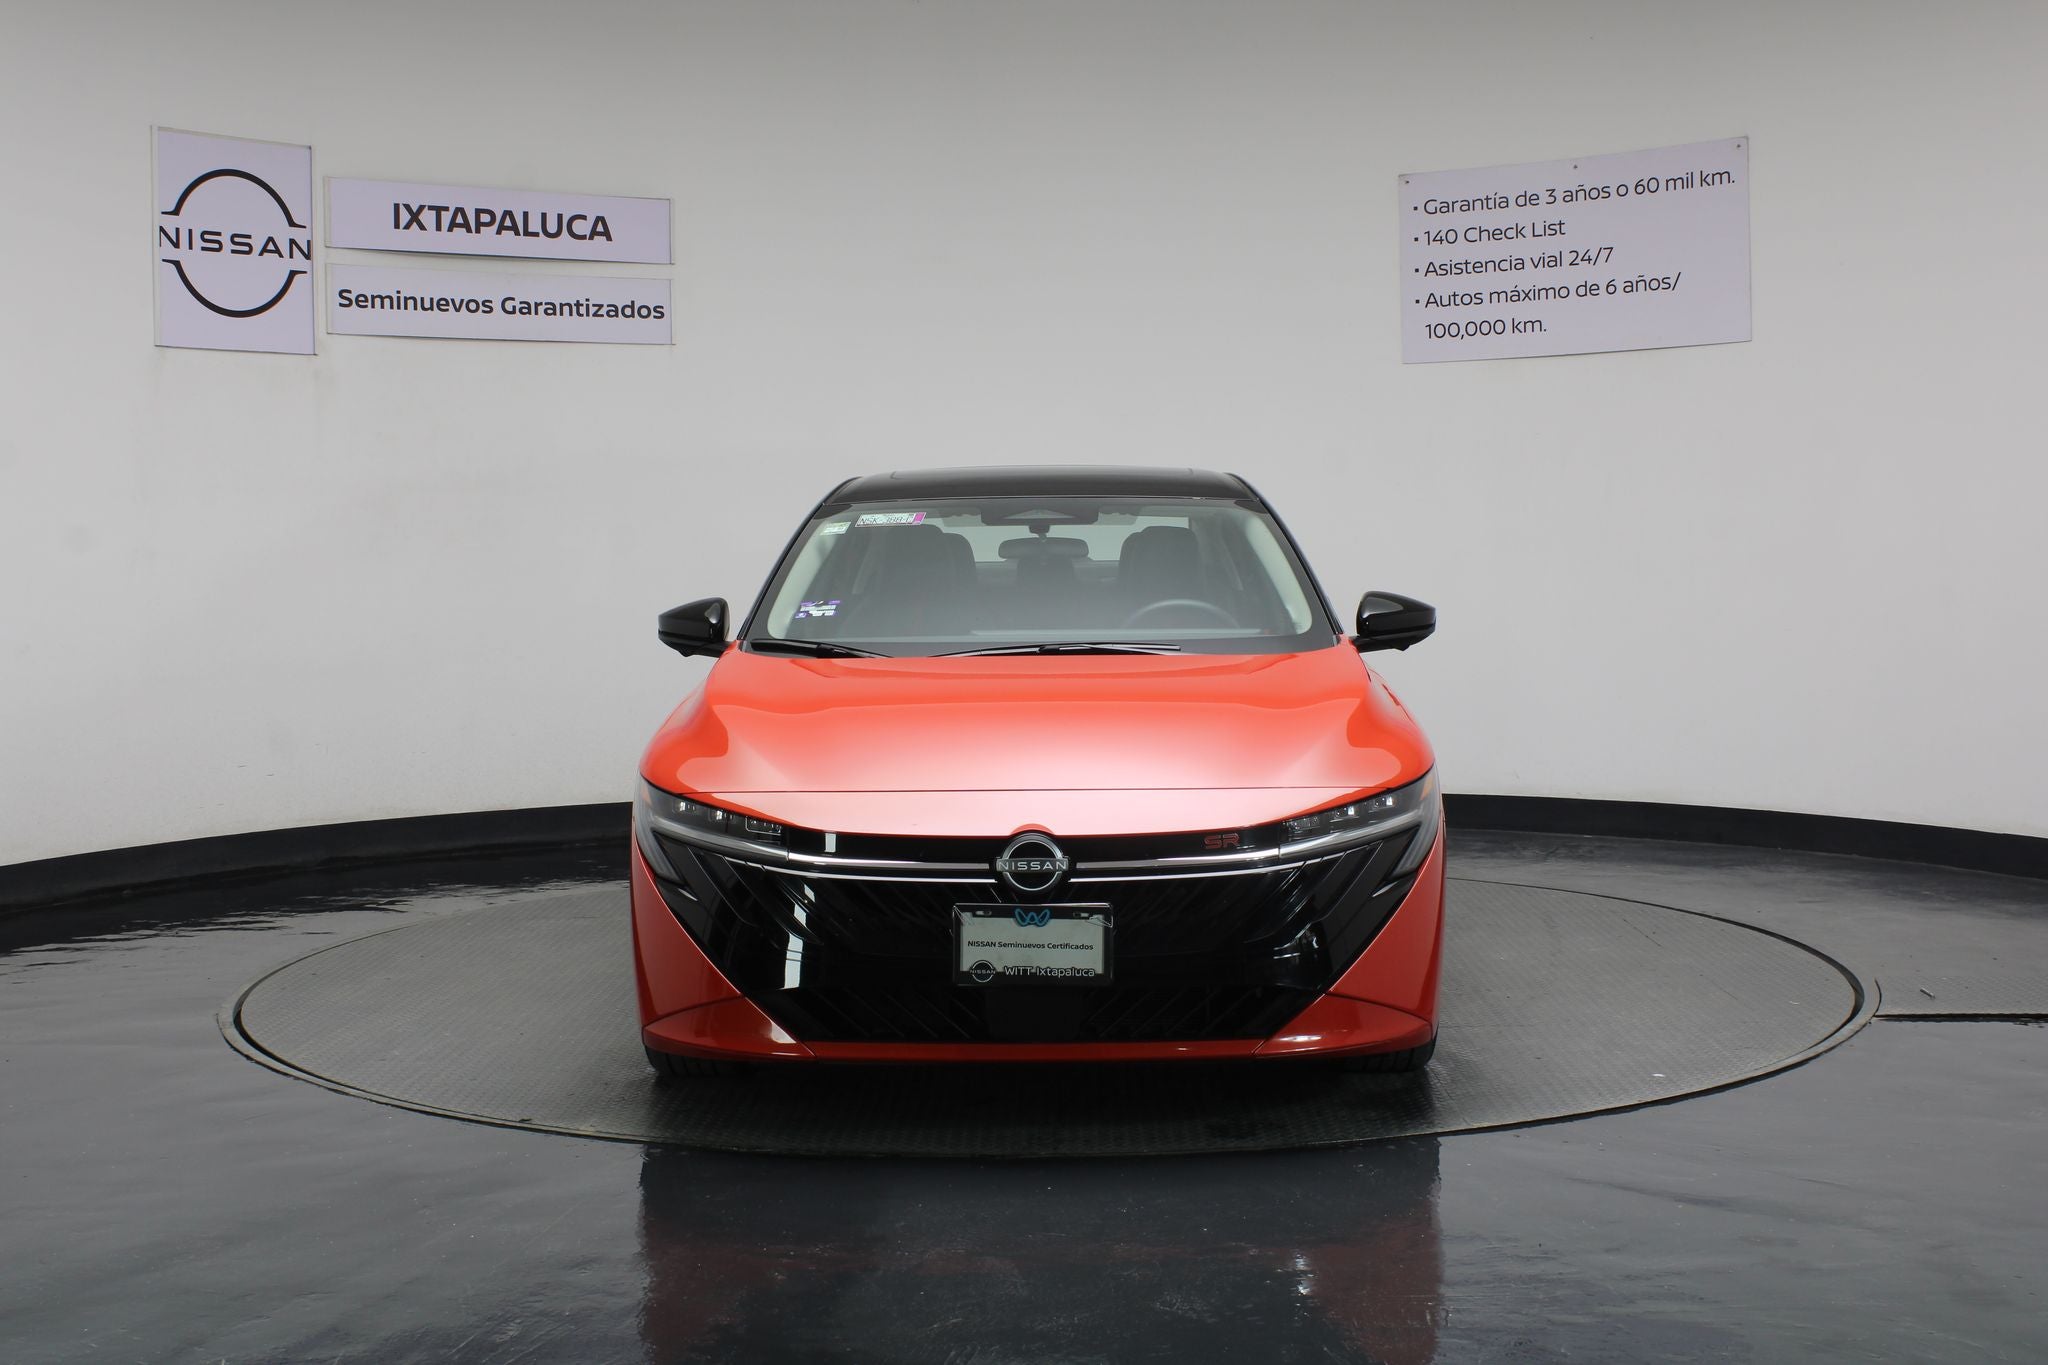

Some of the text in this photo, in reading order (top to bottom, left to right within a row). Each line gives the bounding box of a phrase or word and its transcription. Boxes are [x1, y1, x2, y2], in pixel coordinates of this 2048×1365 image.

[1424, 170, 1735, 214] Garantía de 3 años o 60 mil km.
[394, 203, 613, 242] IXTAPALUCA
[1424, 220, 1566, 246] 140 Check List
[159, 225, 311, 261] NISSAN
[1424, 247, 1614, 277] Asistencia vial 24/7
[338, 289, 664, 319] Seminuevos Garantizados
[1425, 272, 1681, 308] Autos máximo de 6 años/
[1425, 318, 1546, 340] 100,000 km.
[1204, 833, 1240, 849] SR
[999, 861, 1067, 870] NISSAN
[967, 940, 997, 948] NISSAN
[998, 941, 1046, 949] Seminuevos
[1004, 966, 1095, 978] WITT Ixtapaluca
